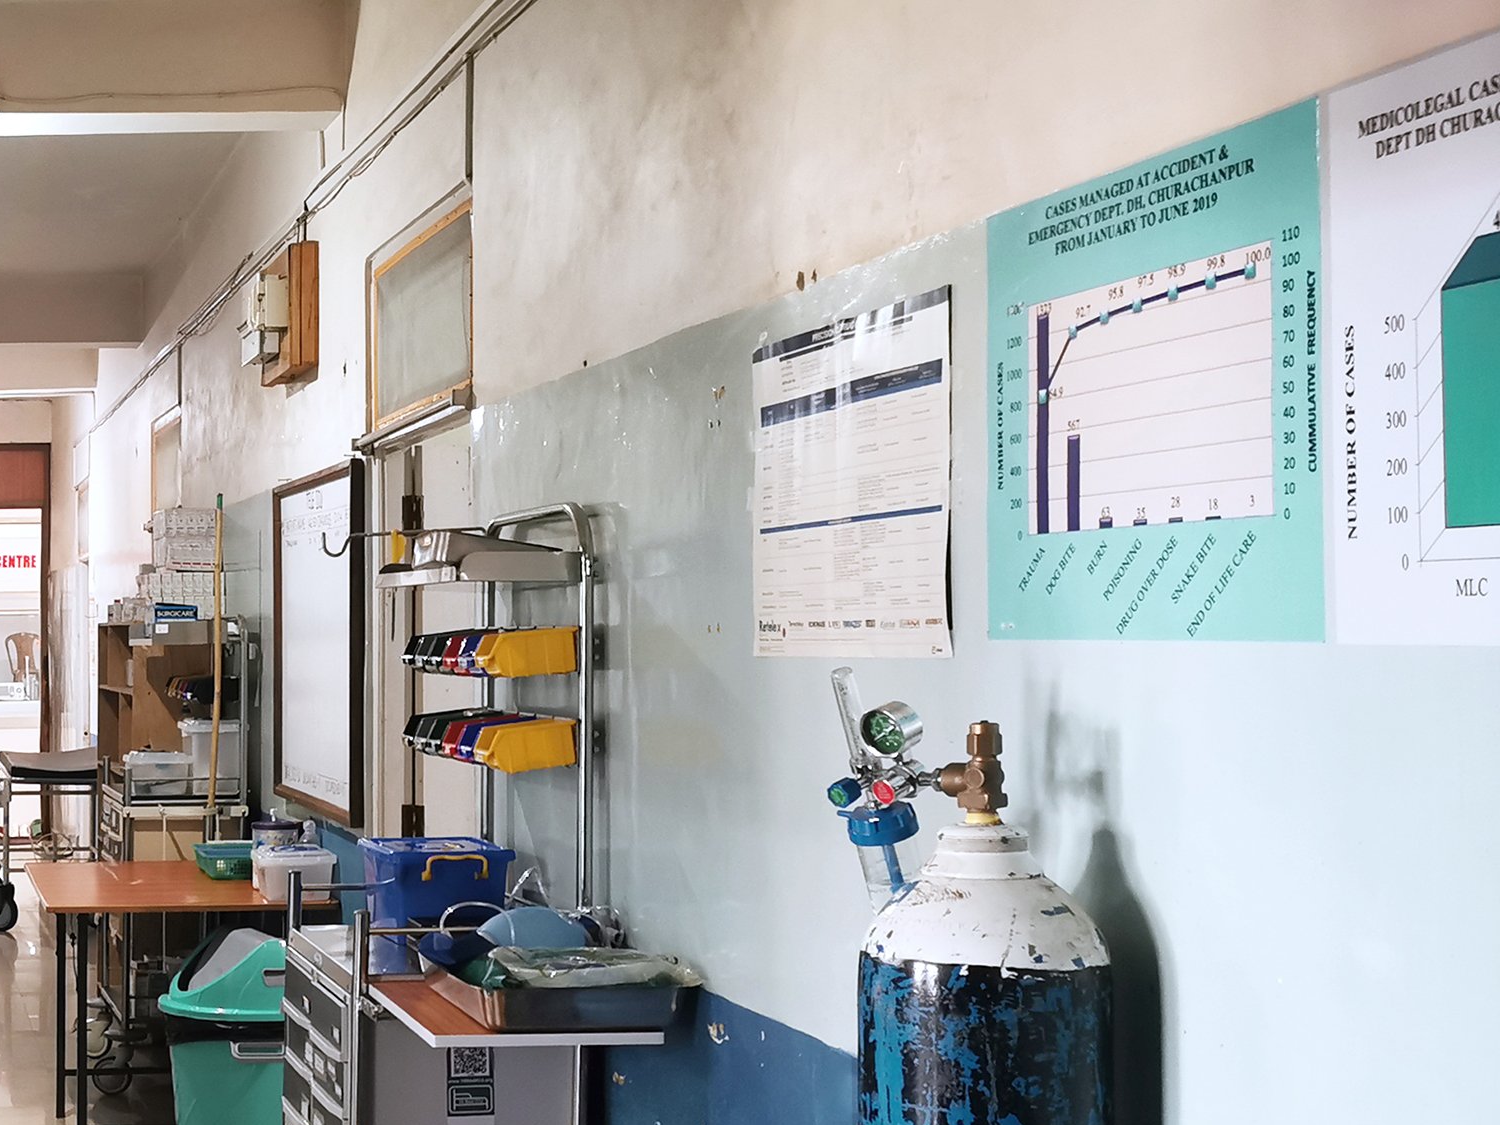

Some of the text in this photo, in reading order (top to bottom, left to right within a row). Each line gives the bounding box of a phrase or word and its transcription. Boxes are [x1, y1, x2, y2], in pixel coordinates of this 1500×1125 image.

[1358, 87, 1466, 139] MEDICOLEGAL
[1376, 132, 1413, 159] DEPT
[1416, 124, 1436, 146] DH
[1045, 144, 1229, 220] CASES MANAGED AT ACCIDENT &
[1028, 212, 1092, 246] EMERGENCY
[1094, 201, 1125, 225] DEPT.
[1148, 158, 1255, 207] CHURACHANPUR
[1055, 192, 1219, 256] FROM JANUARY TO JUNE 2019
[1282, 226, 1300, 242] 110
[1206, 255, 1226, 271] 99.8
[1245, 247, 1272, 265] 100.0
[1282, 252, 1301, 267] 100
[1282, 279, 1295, 293] 90
[1283, 305, 1295, 318] 80
[1384, 314, 1405, 334] 500
[1007, 336, 1022, 350] 1200
[1283, 329, 1295, 343] 70
[1283, 355, 1295, 368] 60
[1007, 368, 1022, 382] 1000
[1307, 270, 1317, 472] CUMMULATIVE FREQUENCY
[1384, 362, 1406, 381] 400
[1283, 380, 1295, 394] 50
[1010, 401, 1022, 413] 800
[1283, 406, 1296, 418] 40
[997, 411, 1003, 427] OF
[1386, 410, 1407, 429] 300
[1010, 433, 1022, 445] 600
[1283, 431, 1296, 444] 30
[1344, 324, 1357, 541] NUMBER OF CASES
[1284, 457, 1296, 469] 20
[1386, 458, 1408, 476] 200
[1010, 466, 1022, 477] 400
[1284, 482, 1296, 495] 10
[1010, 498, 1022, 510] 200
[1171, 496, 1181, 509] 28
[1208, 499, 1218, 511] 18
[1249, 495, 1255, 507] 3
[1284, 508, 1291, 520] 0
[1388, 506, 1408, 524] 100
[1018, 530, 1023, 541] 0
[1087, 540, 1108, 575] BURN
[1402, 554, 1409, 571] 0
[1018, 547, 1046, 592] TRAUMA
[1045, 543, 1077, 595] DOG BITE
[1103, 538, 1142, 601] POISONING
[1171, 533, 1217, 604] SNAKE BITE
[1116, 536, 1179, 635] DRUG OVER DOSE
[1186, 530, 1257, 637] END OF LIFE CARE
[1455, 577, 1489, 597] MLC
